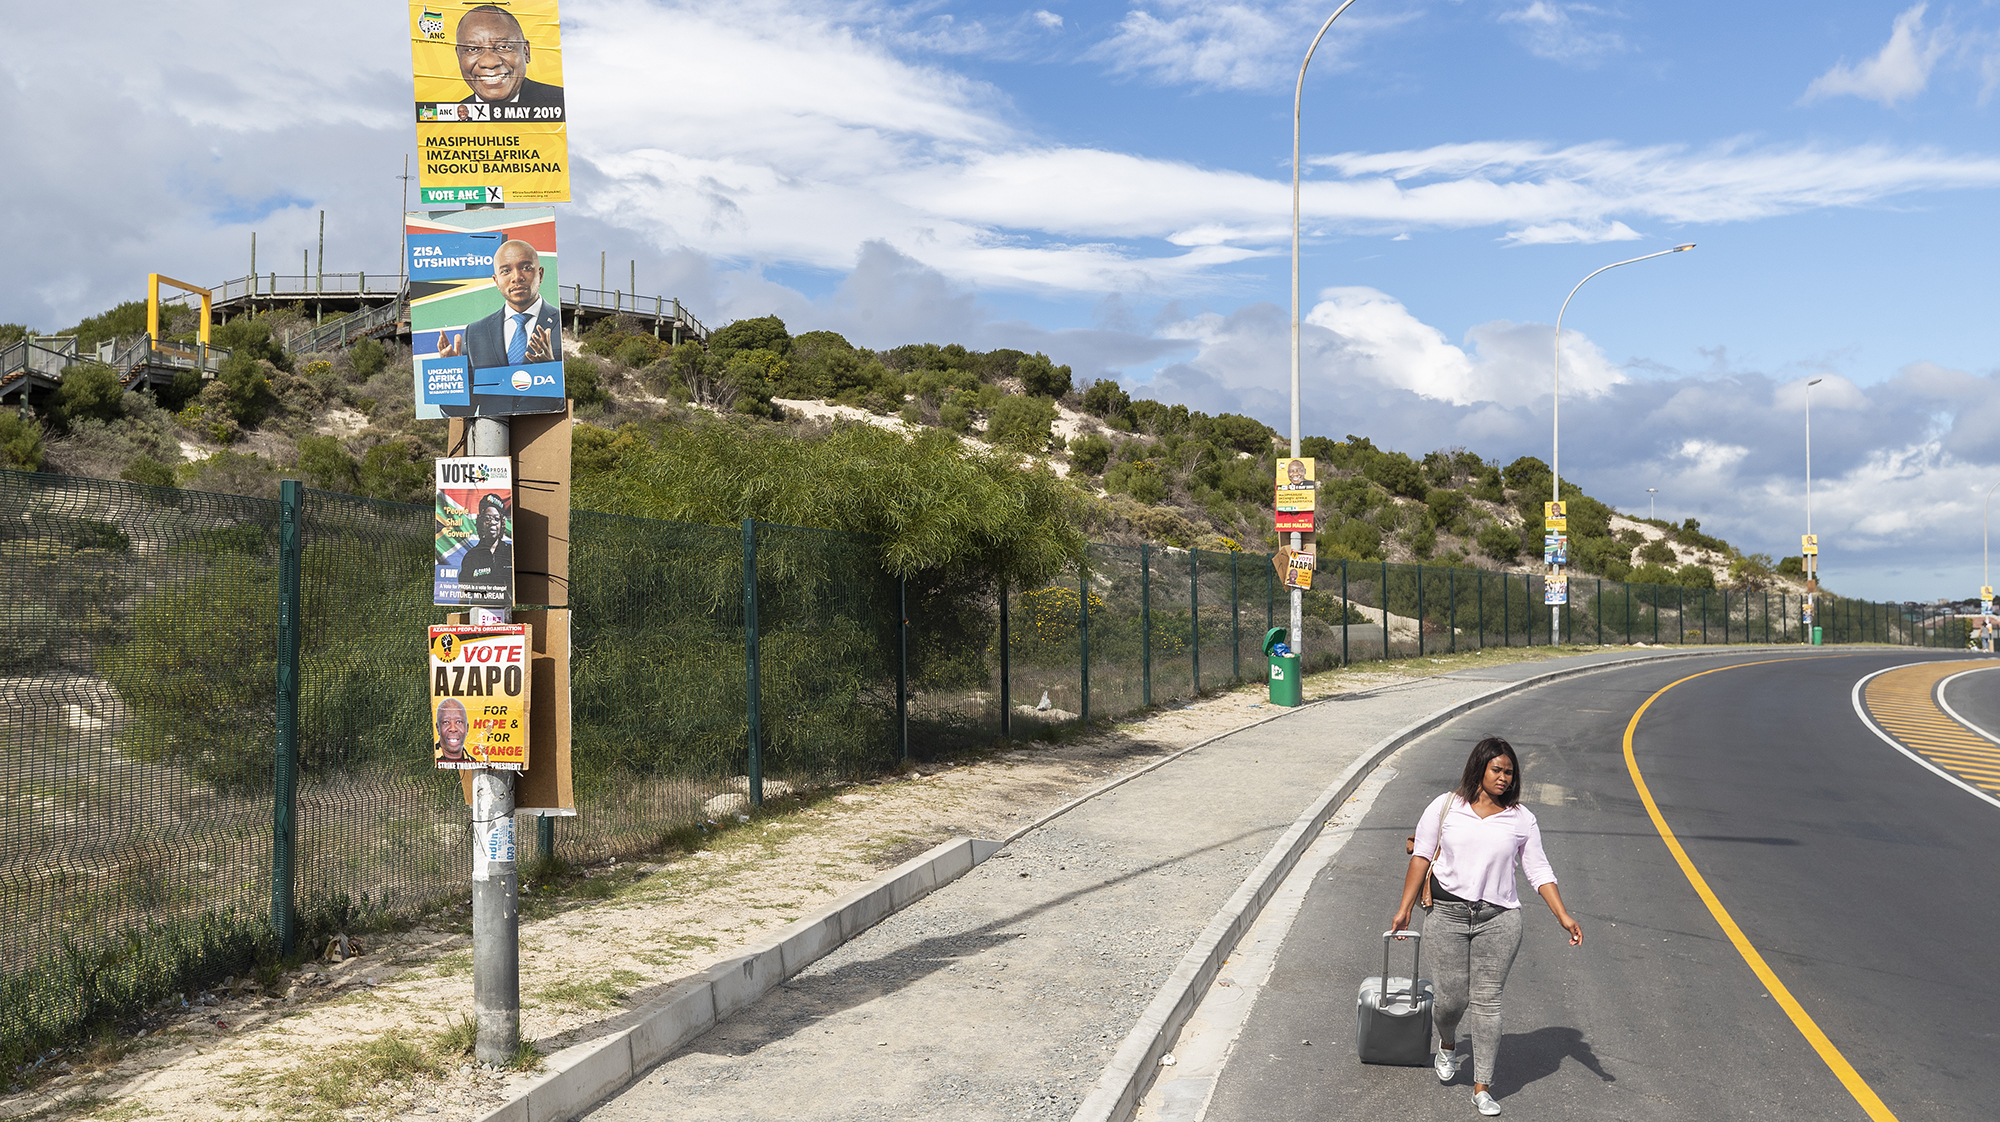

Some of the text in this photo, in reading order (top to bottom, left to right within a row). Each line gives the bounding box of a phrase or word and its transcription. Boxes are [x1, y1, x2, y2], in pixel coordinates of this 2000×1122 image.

[493, 106, 562, 119] 8 MAY 2019
[426, 136, 520, 147] MASIPHUHLISE
[427, 149, 541, 161] IMZANTSI AFRIKA
[428, 162, 561, 174] NGOKU BAMBISANA
[428, 189, 480, 201] VOTE ANC
[413, 246, 443, 257] ZISA
[414, 256, 493, 269] UTSHINTSHO
[427, 367, 464, 376] UMZANTSI
[428, 374, 464, 383] AFRIKA
[533, 375, 556, 387] DA
[428, 381, 465, 391] OMNYE
[441, 463, 475, 483] VOTE
[446, 518, 463, 526] Shall
[1289, 560, 1313, 571] AZAPO
[440, 568, 459, 578] 8 MAY
[463, 645, 523, 663] VOTE
[434, 664, 522, 697] AZAPO
[484, 705, 508, 715] FOR
[473, 719, 519, 729] HOPE &
[487, 733, 510, 742] FOR
